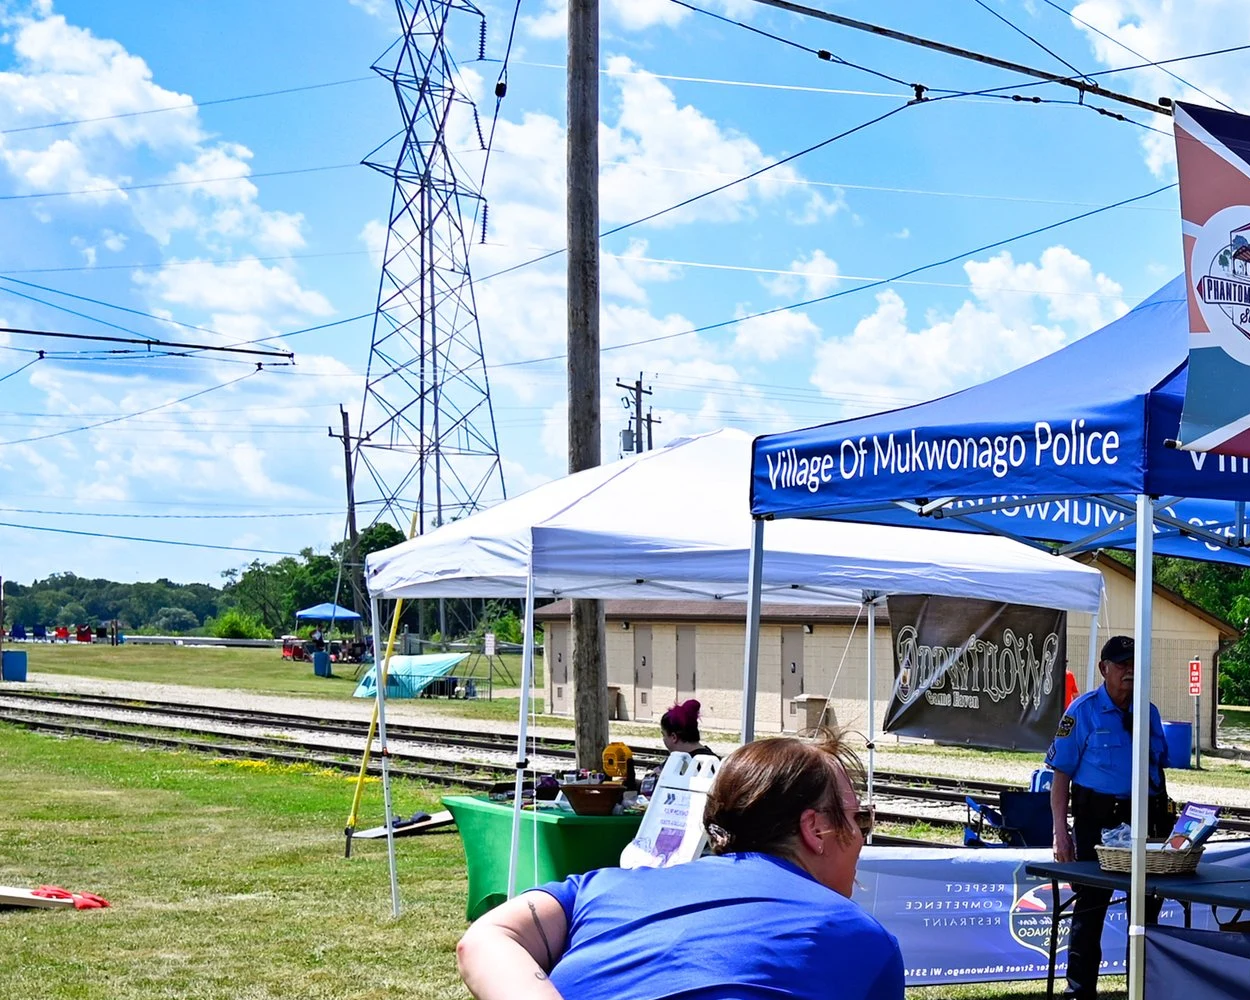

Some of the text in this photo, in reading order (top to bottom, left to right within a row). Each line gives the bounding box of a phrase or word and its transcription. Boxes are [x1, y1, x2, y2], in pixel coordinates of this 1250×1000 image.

[1206, 279, 1250, 304] PHANTOM
[766, 418, 1120, 493] Village Of Mukwonago Police
[952, 691, 980, 709] Haven
